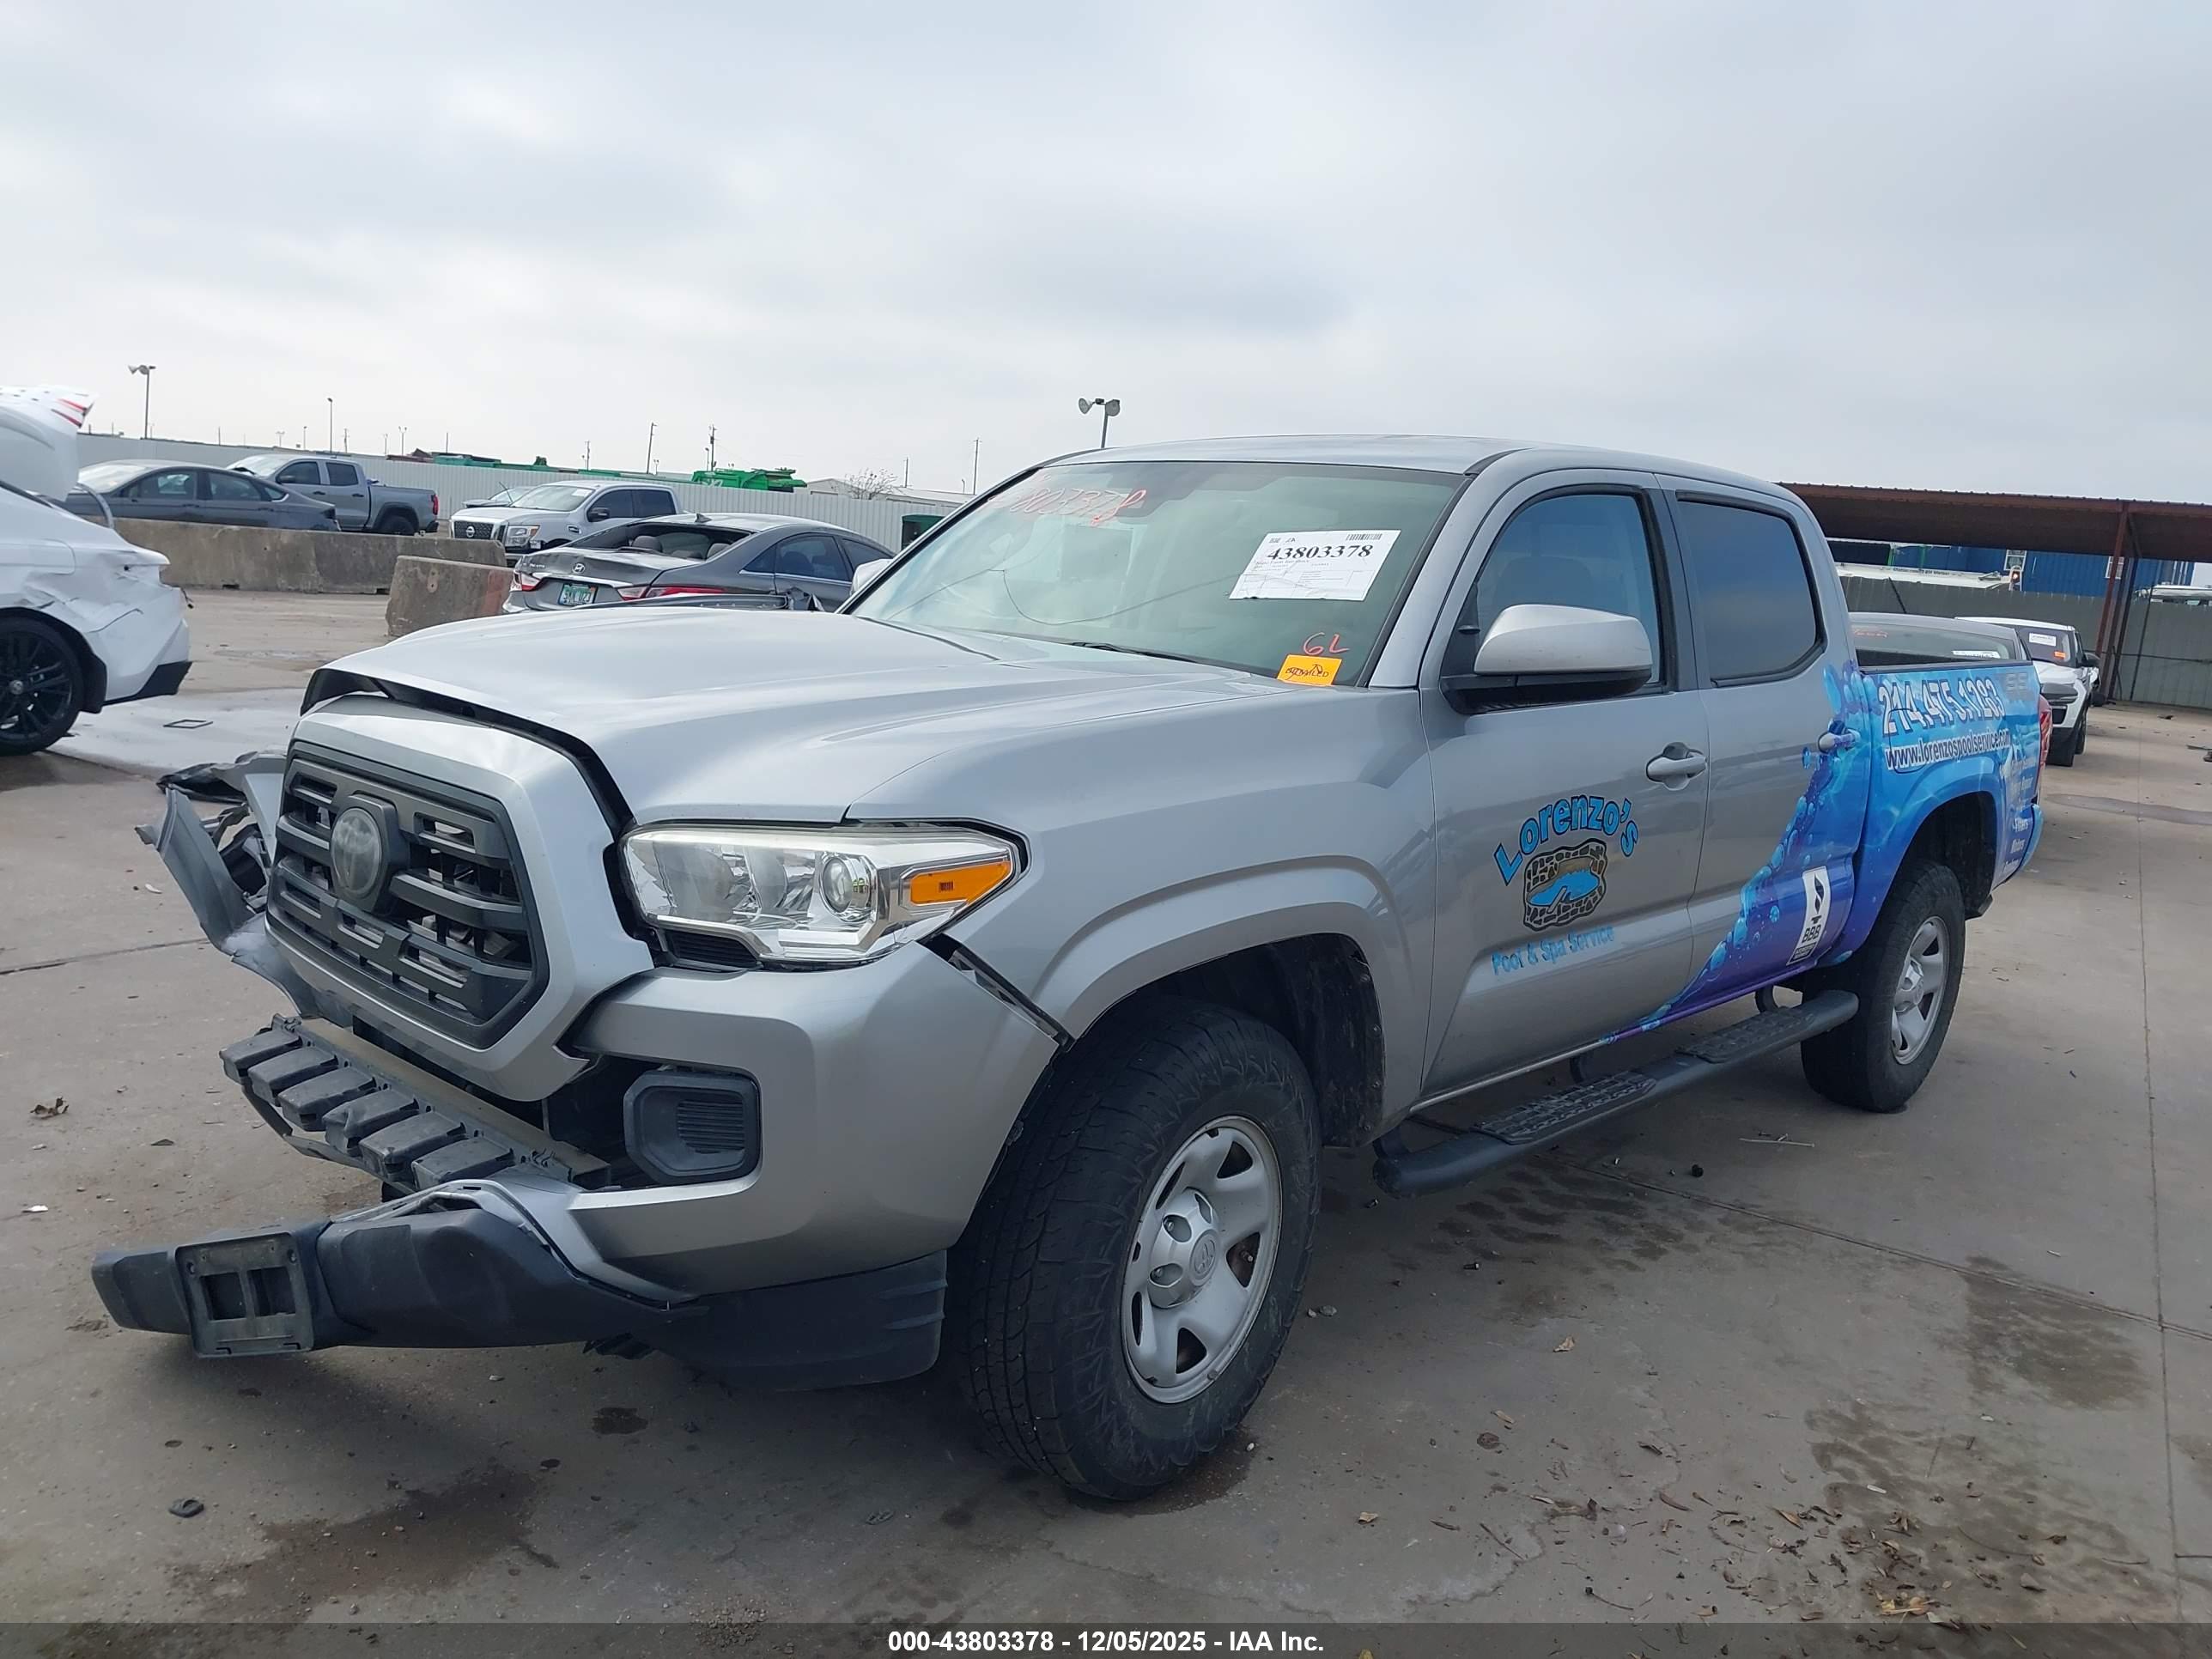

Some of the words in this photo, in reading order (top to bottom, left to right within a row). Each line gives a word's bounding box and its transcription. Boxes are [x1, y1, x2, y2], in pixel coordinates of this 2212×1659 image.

[1267, 544, 1374, 560] 43803378
[1884, 727, 2012, 769] www.lorenzospoolservice.com
[1493, 794, 1638, 887] Lorenzo's
[1492, 948, 1524, 976] Pool
[1527, 943, 1539, 965] &
[1540, 939, 1567, 964] Spa
[1567, 925, 1615, 953] Service
[1802, 924, 1821, 943] BBB
